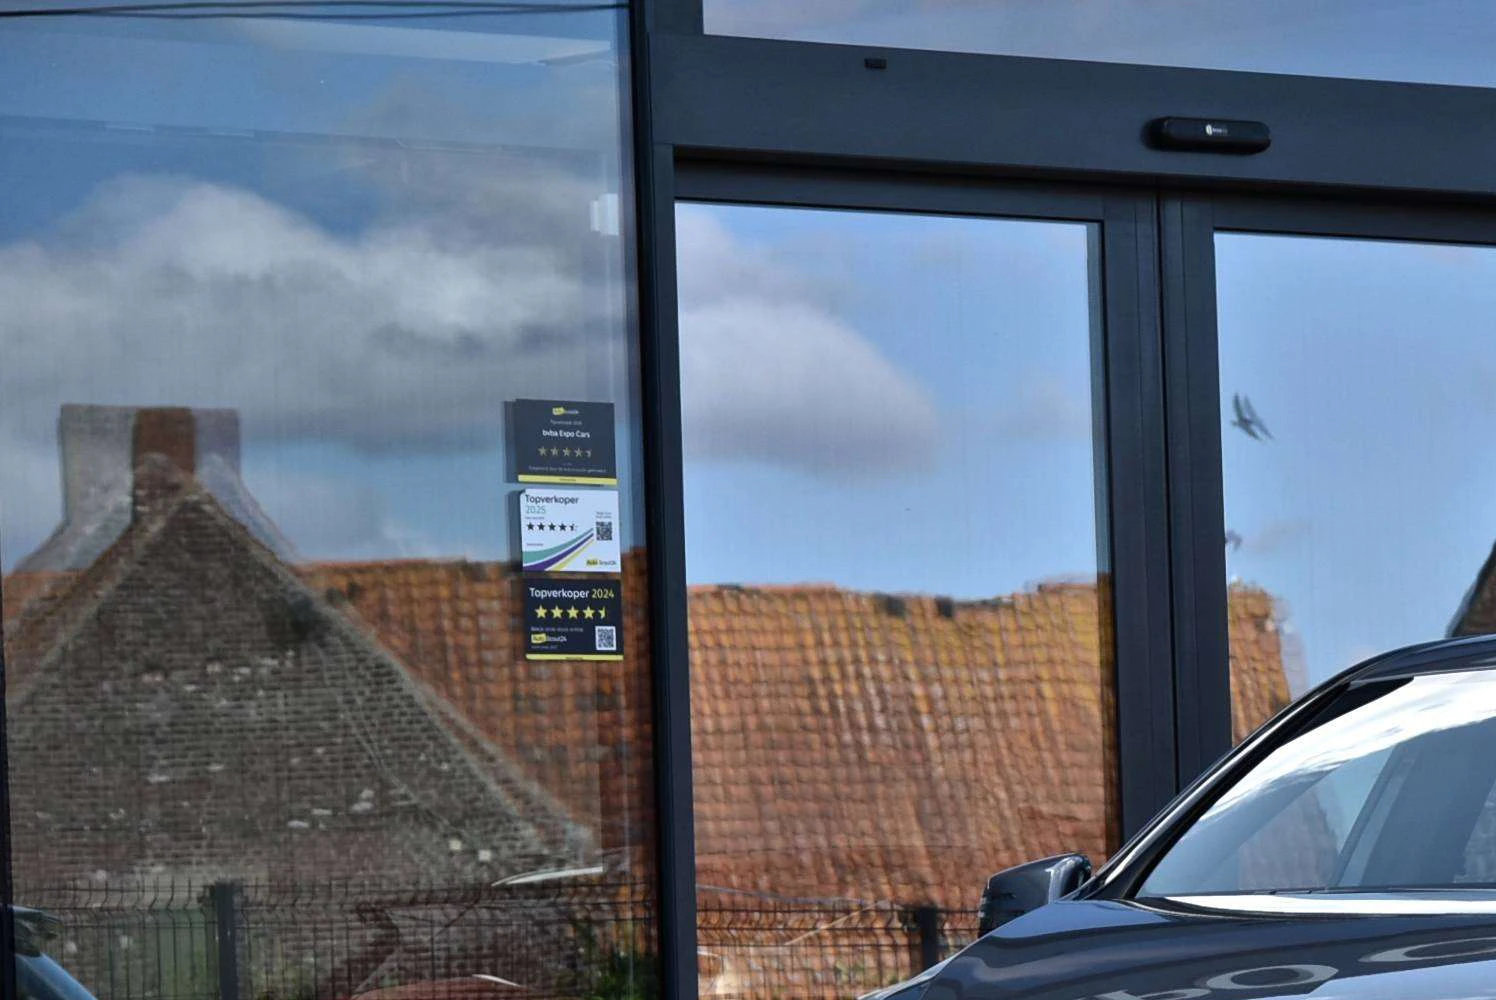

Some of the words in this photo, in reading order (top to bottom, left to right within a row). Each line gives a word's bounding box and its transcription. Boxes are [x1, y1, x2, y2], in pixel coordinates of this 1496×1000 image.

[542, 429, 558, 437] bvba
[559, 430, 575, 438] Expo
[575, 430, 591, 438] Cars
[525, 494, 579, 505] Topverkoper
[526, 505, 546, 514] 2025
[529, 587, 590, 599] Topverkoper
[591, 588, 615, 599] 2024
